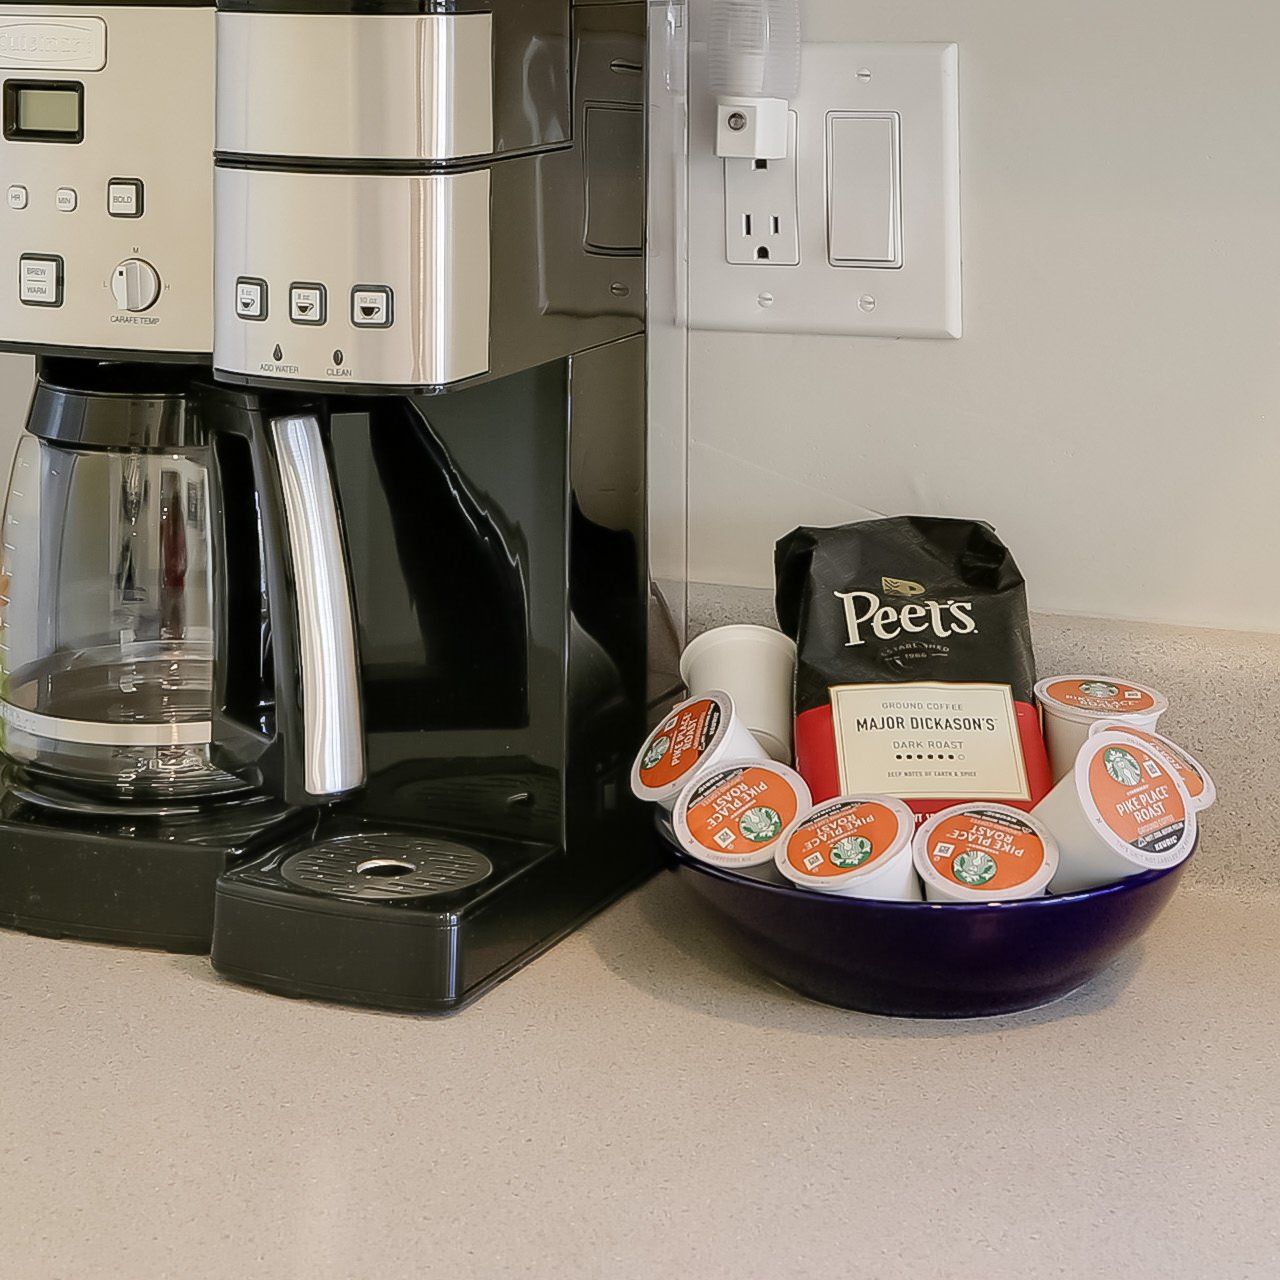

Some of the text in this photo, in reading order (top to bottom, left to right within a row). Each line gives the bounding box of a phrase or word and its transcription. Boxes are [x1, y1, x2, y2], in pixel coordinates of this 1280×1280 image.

[11, 193, 21, 202] HR
[58, 196, 71, 205] MIN
[113, 195, 133, 205] BOLD
[26, 267, 47, 276] BREW
[26, 286, 47, 295] WARM
[110, 316, 160, 325] CARAFE TEMP
[260, 363, 299, 373] ADD WATER
[326, 369, 352, 377] CLEAN
[882, 701, 963, 711] GROUND COFFEE
[856, 717, 996, 732] MAJOR DICKASON'S
[893, 740, 964, 750] DARK ROAST
[711, 782, 749, 812] ROAST
[741, 780, 769, 802] PIKE
[1116, 785, 1169, 817] PIKE PLACE
[706, 798, 743, 828] PLACE
[1133, 801, 1166, 824] ROAST
[816, 813, 857, 836] ROAST
[951, 829, 992, 847] PLACE
[970, 824, 1014, 844] ROAST
[993, 840, 1025, 858] PIKE
